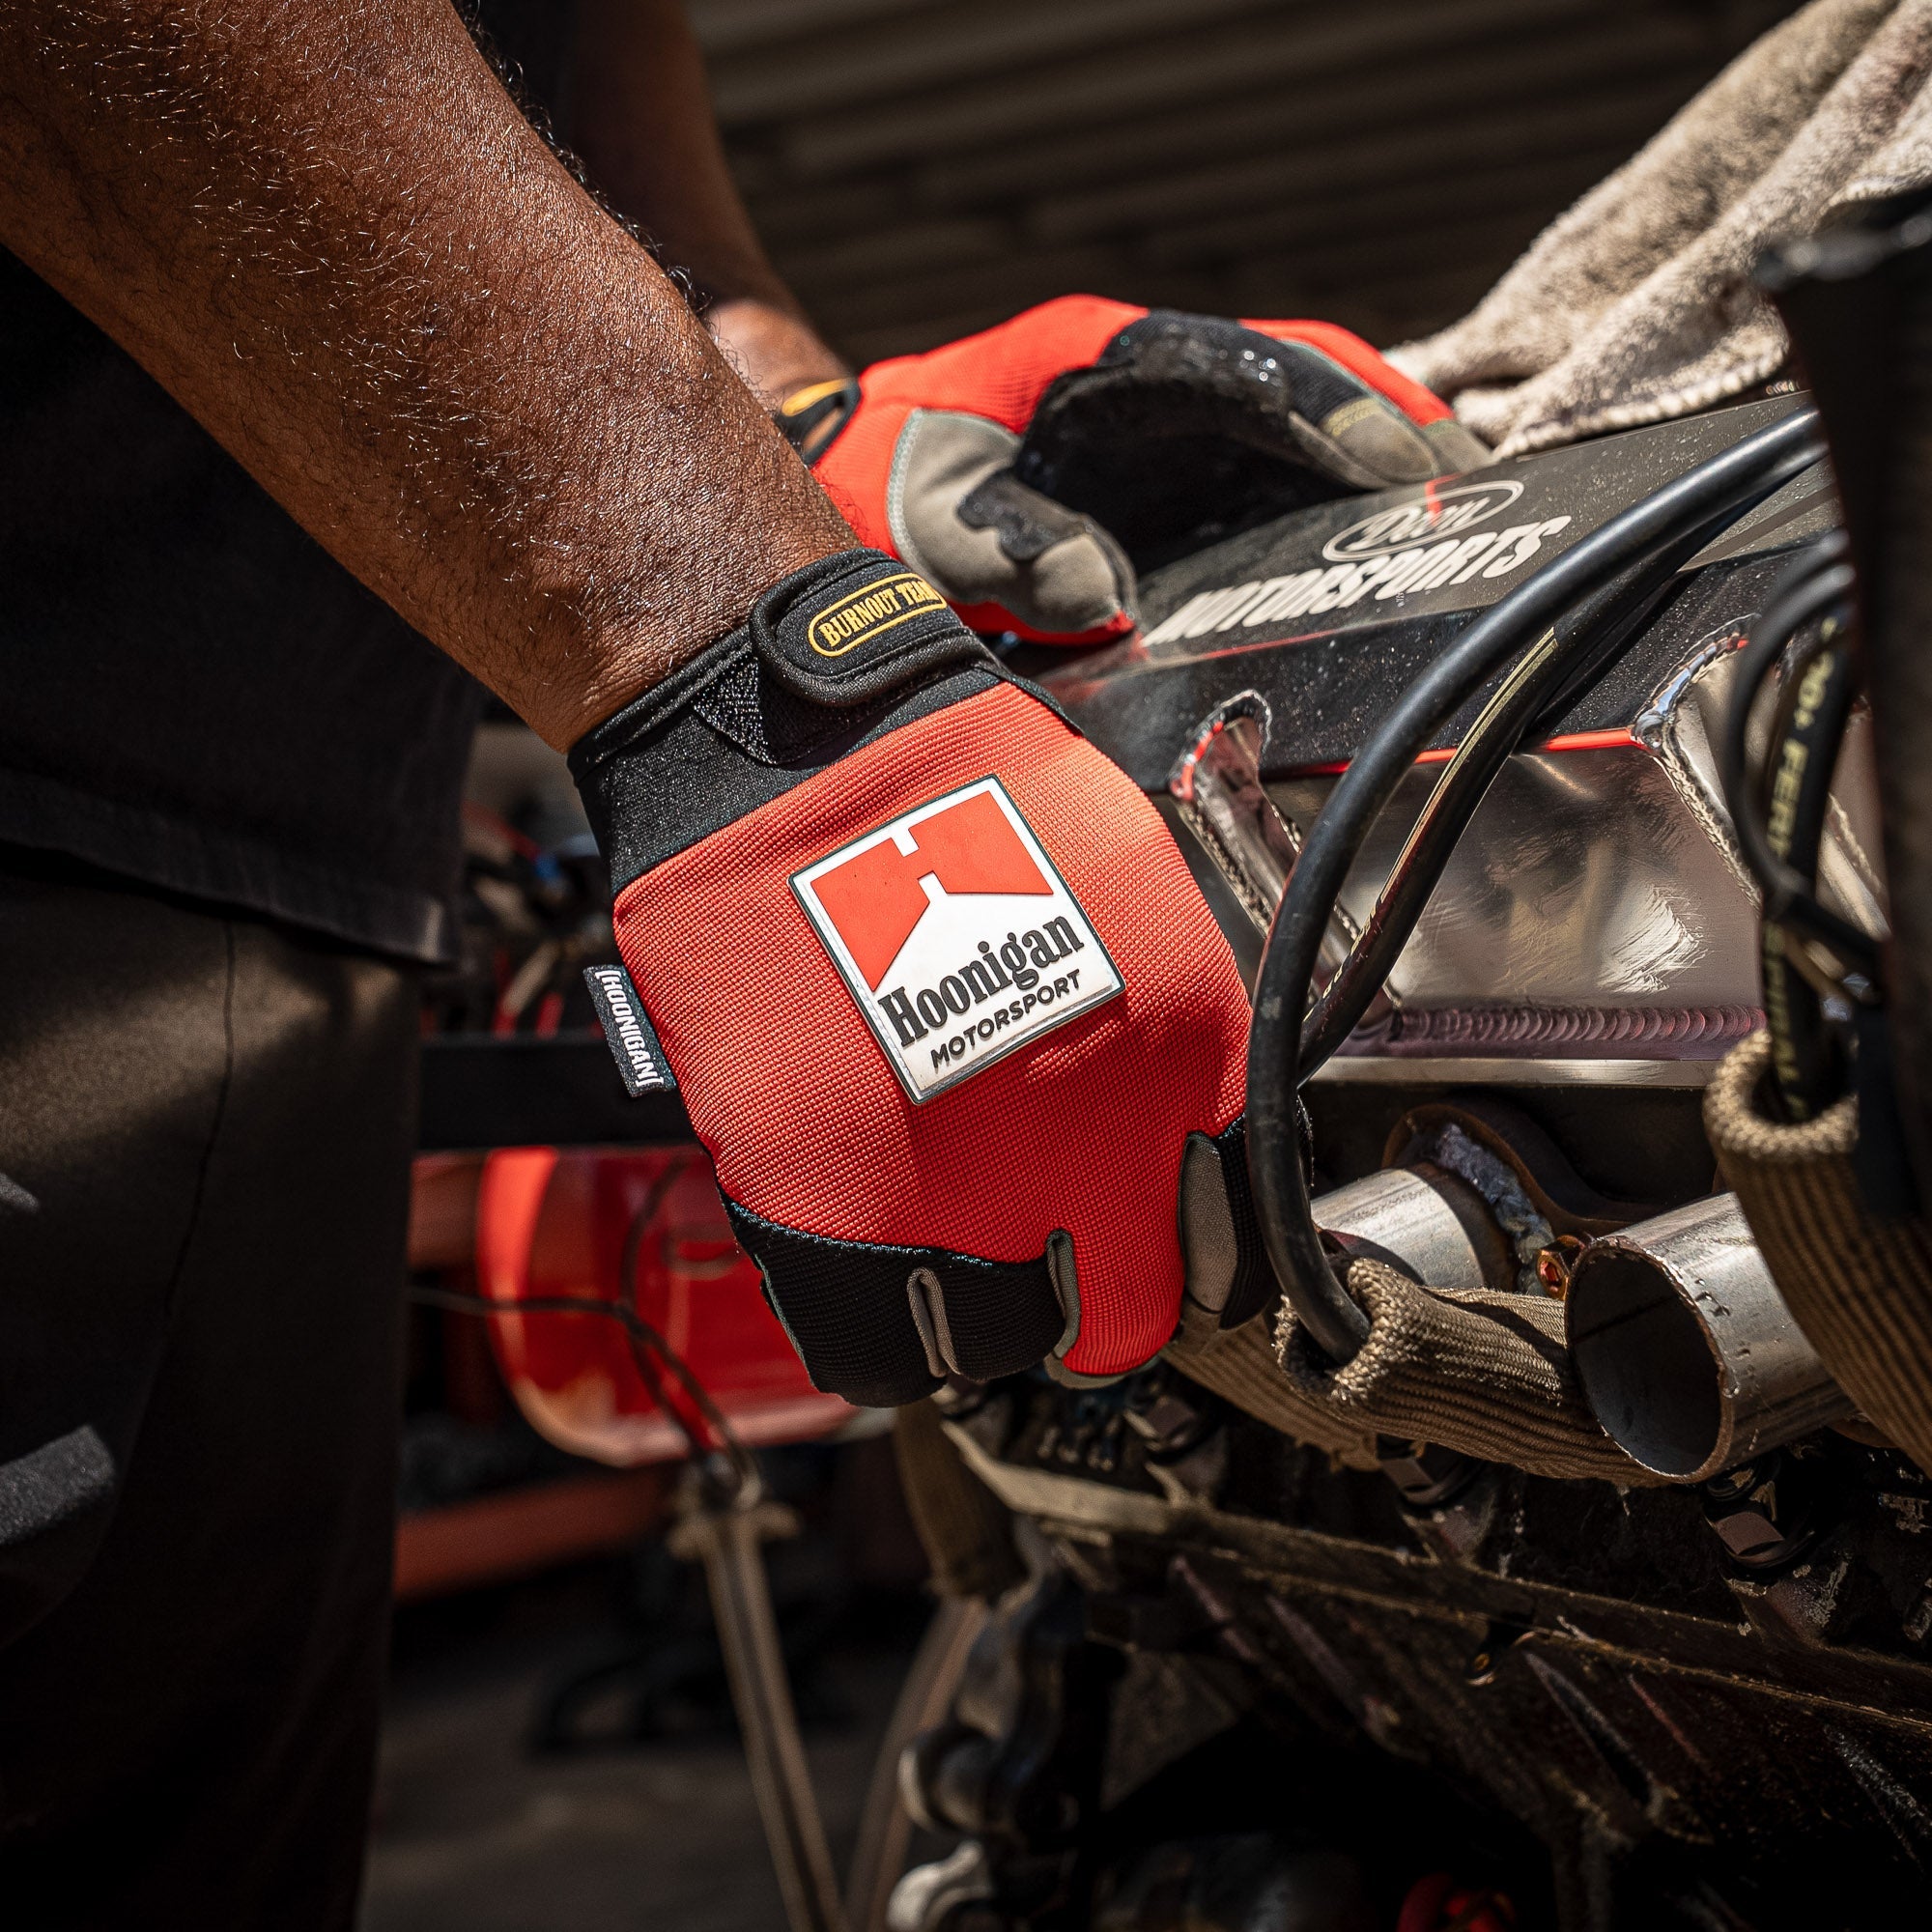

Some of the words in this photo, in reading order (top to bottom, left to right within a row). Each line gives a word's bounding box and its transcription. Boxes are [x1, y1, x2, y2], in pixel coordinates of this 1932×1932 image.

[818, 587, 902, 647] BURNOUT
[1140, 515, 1572, 648] MOTORSPORTS
[878, 916, 1085, 1048] Hoonigan
[930, 969, 1081, 1069] MOTORSPORT
